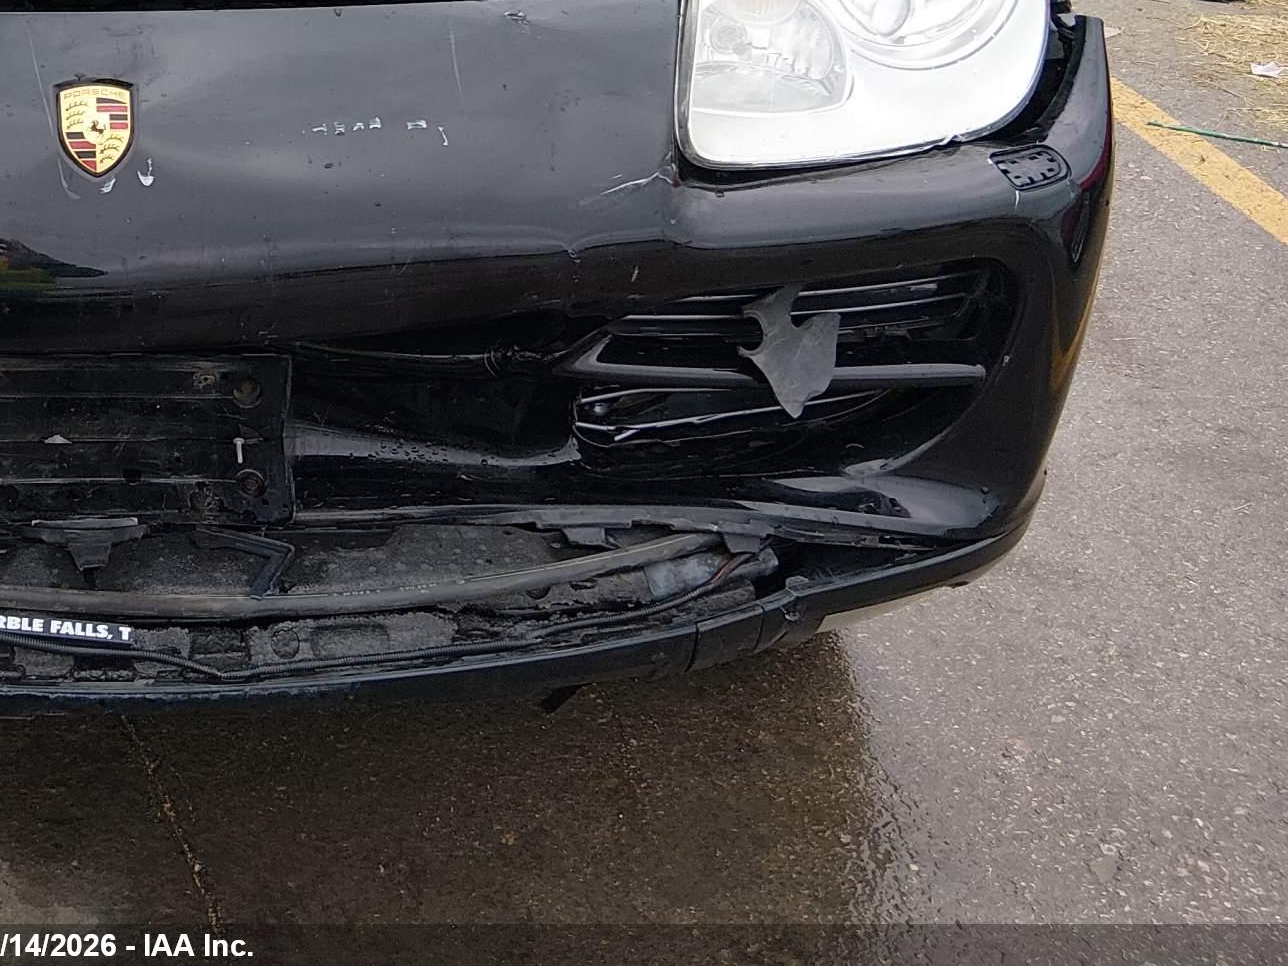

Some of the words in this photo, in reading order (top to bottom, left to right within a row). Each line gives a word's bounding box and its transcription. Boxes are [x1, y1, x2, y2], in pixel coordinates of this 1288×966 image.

[63, 88, 127, 100] PORSCHE
[50, 619, 113, 640] FALLS,
[118, 626, 133, 641] T
